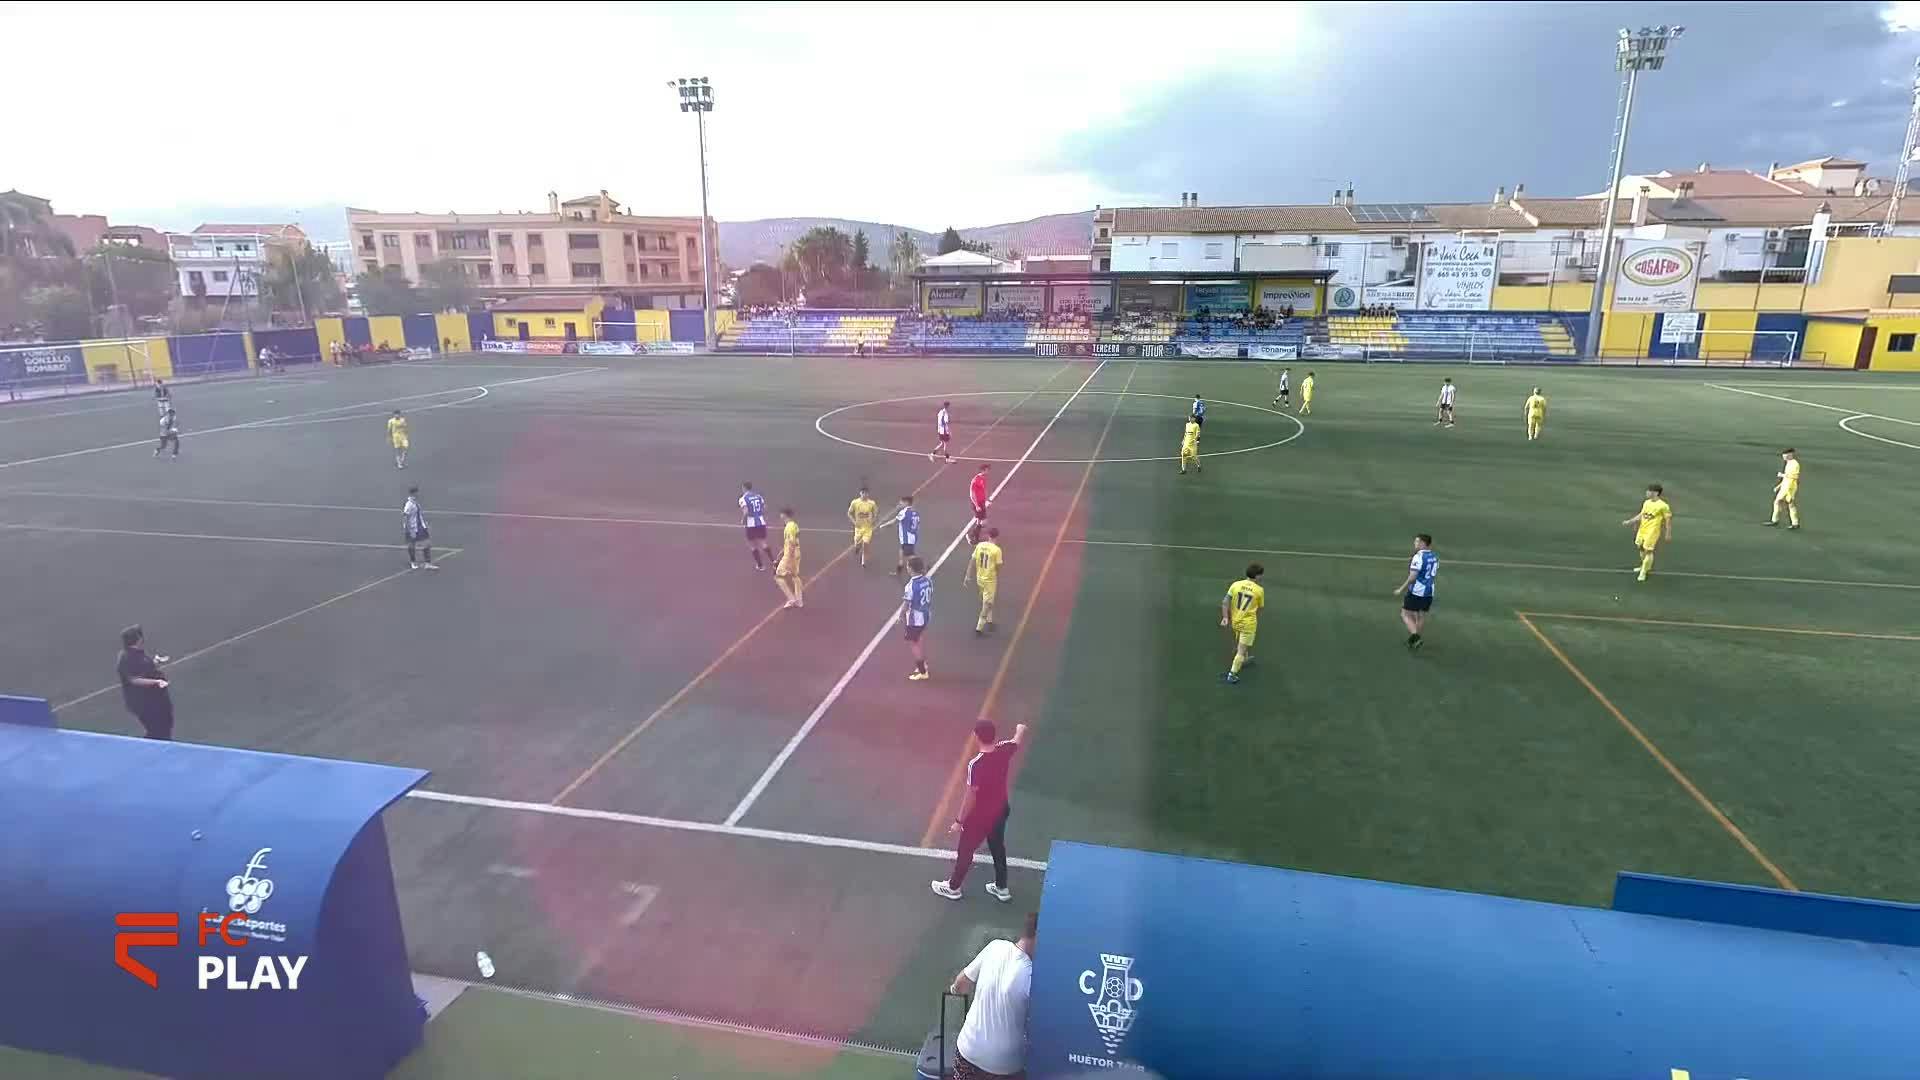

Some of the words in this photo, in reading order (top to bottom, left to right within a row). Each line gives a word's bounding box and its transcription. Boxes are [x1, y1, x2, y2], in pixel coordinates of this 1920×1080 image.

[1037, 343, 1058, 356] FUTUR
[1092, 343, 1120, 353] TERCERA
[1142, 343, 1163, 357] FUTUR
[1236, 591, 1254, 611] 17
[1079, 970, 1096, 994] C
